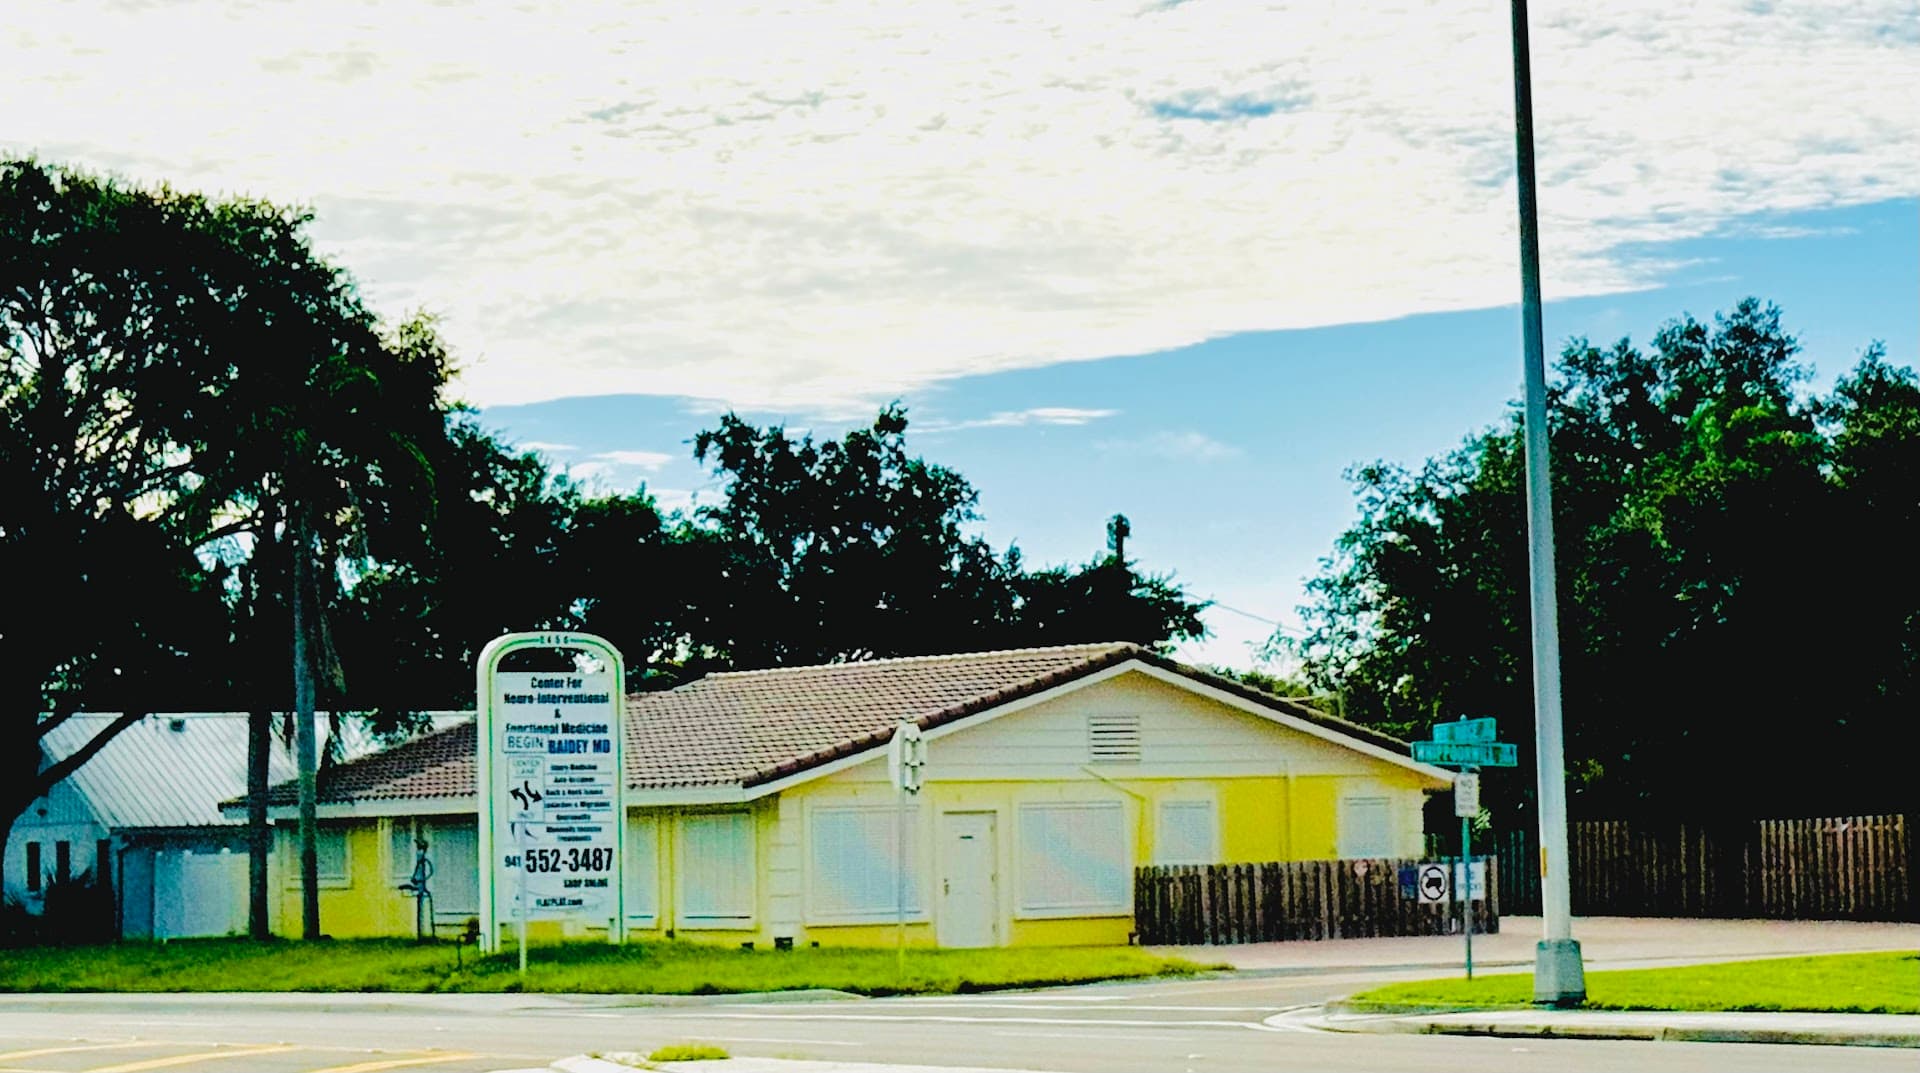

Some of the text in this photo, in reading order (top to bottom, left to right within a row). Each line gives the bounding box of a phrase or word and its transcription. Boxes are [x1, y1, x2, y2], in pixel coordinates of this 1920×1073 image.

[531, 677, 583, 688] Center For
[561, 723, 608, 734] Medicine
[508, 736, 544, 749] BEGIN
[593, 739, 611, 754] MD
[505, 847, 613, 873] 941 552-3487
